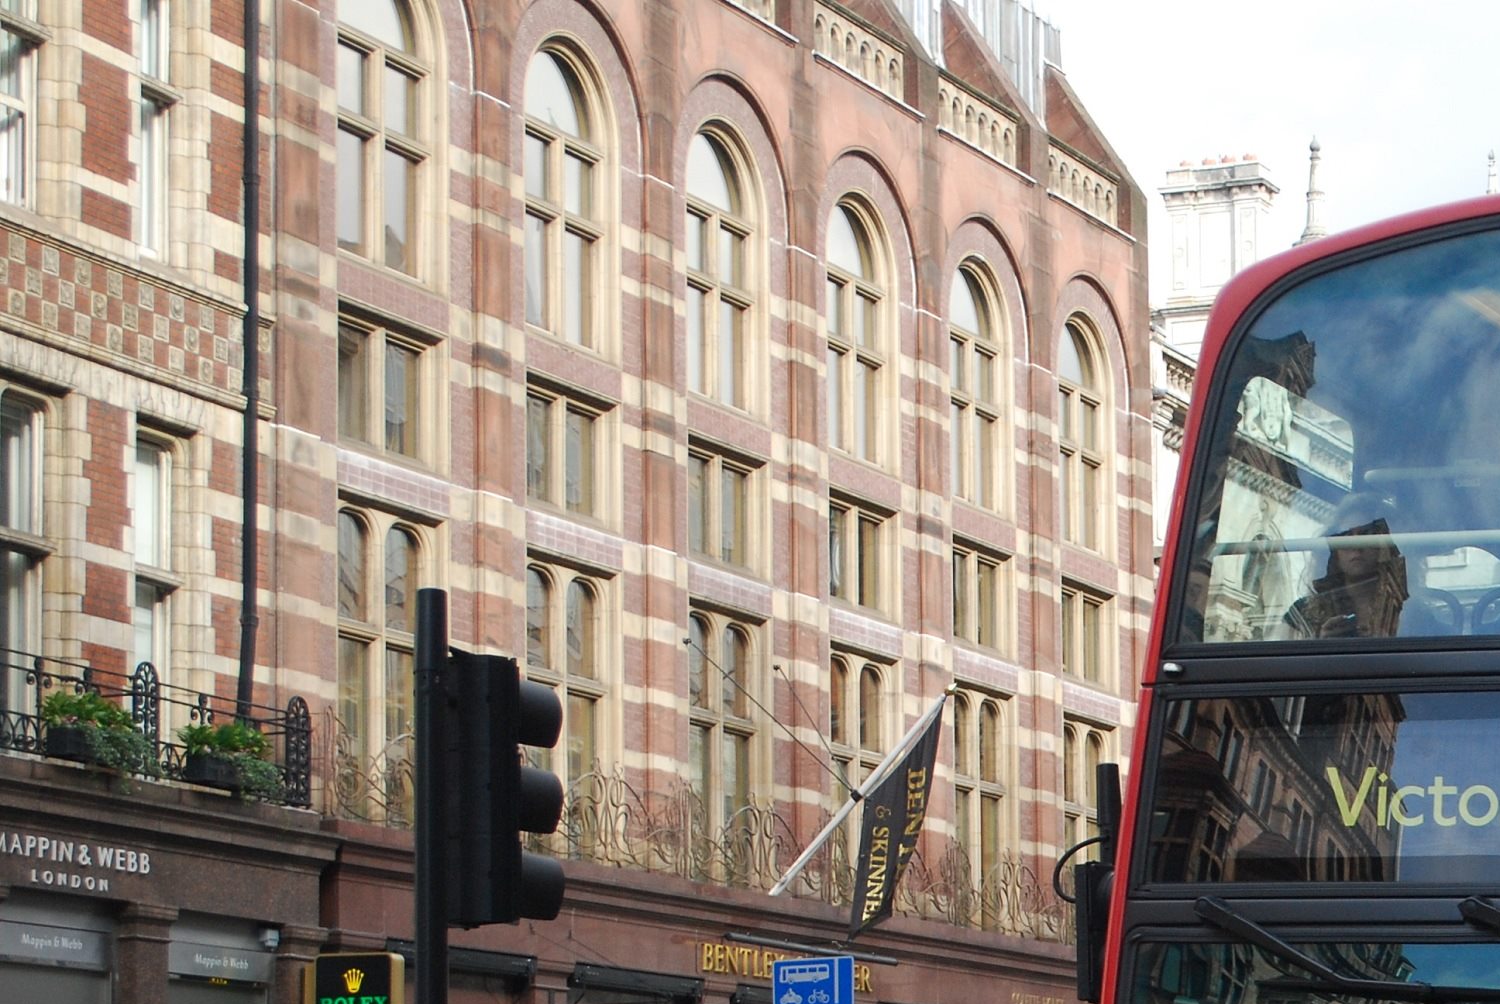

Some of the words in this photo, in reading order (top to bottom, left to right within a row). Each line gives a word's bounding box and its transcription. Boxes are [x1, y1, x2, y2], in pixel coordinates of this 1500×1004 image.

[78, 844, 92, 866] &
[97, 846, 150, 874] WEBB
[31, 868, 109, 892] LONDON
[21, 933, 52, 951] Mappin
[62, 937, 83, 950] Webb
[194, 953, 222, 969] Mappin
[230, 957, 249, 970] Webb
